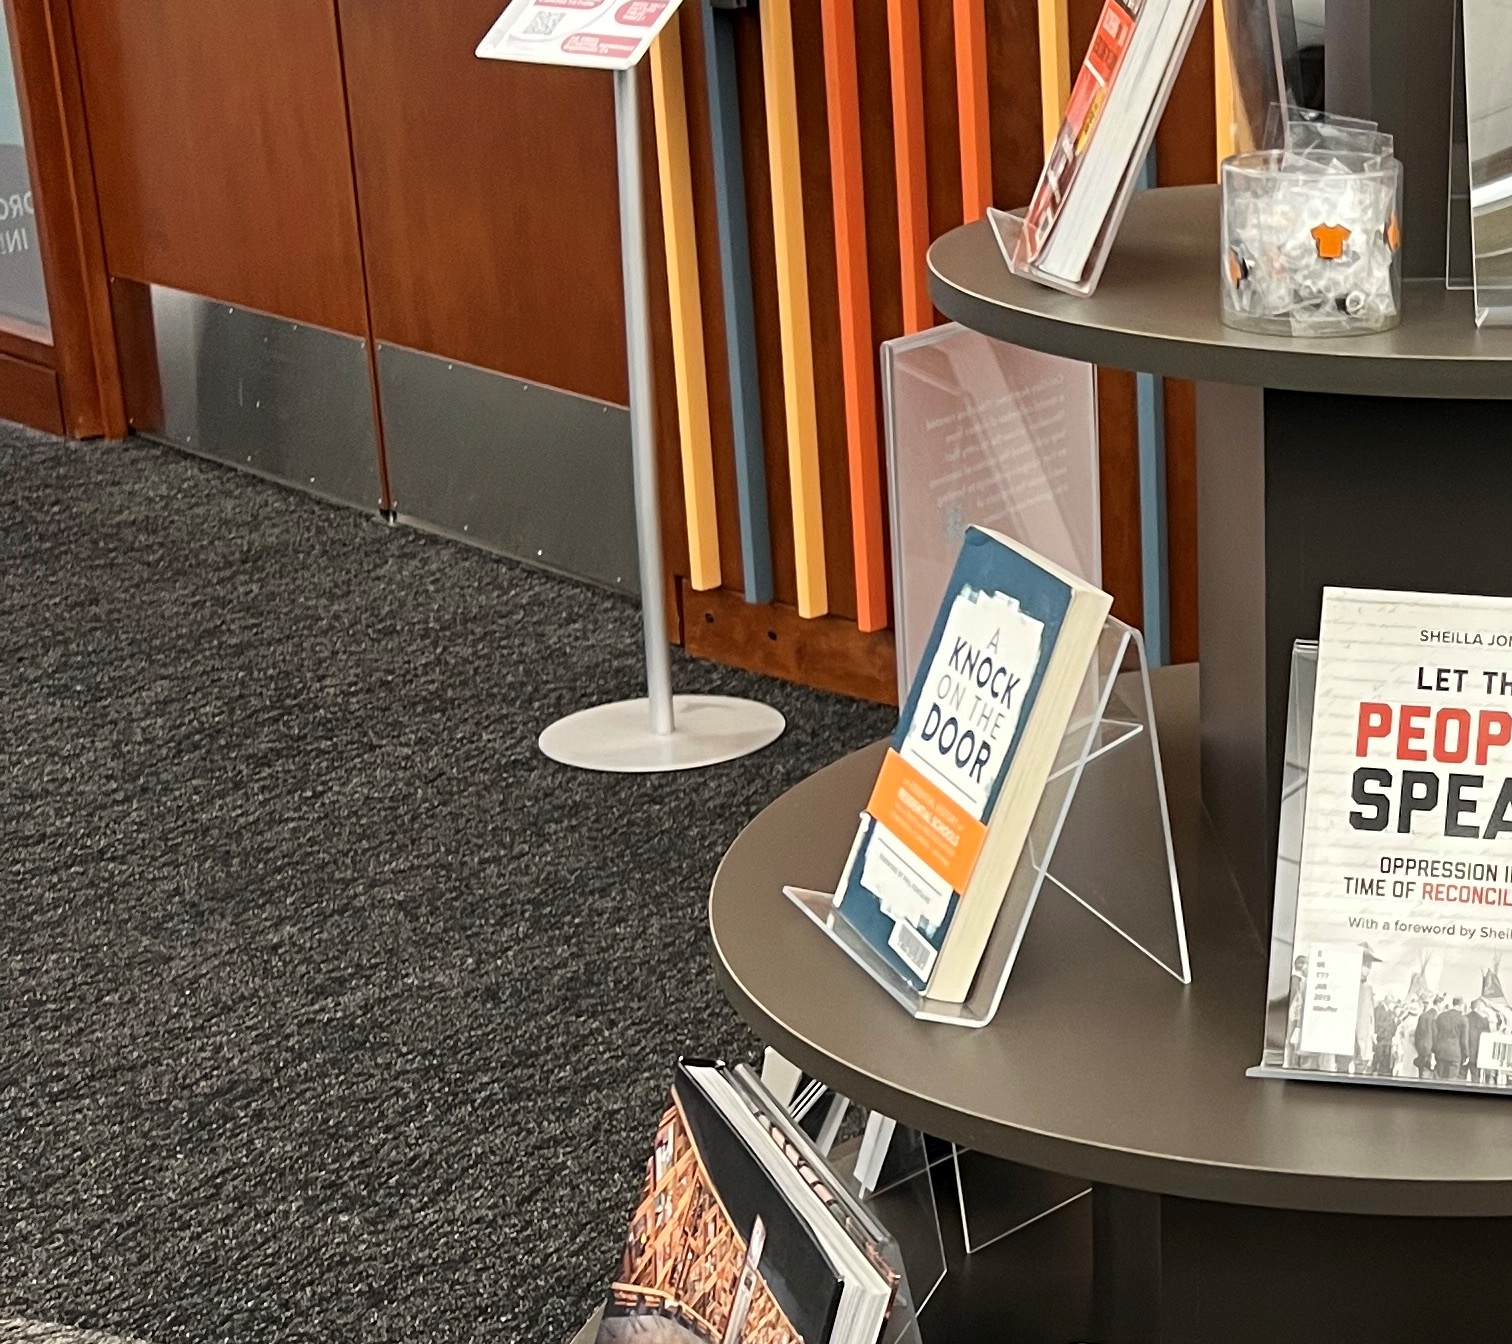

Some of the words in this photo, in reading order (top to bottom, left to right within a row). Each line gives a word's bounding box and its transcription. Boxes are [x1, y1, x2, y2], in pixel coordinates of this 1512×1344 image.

[987, 627, 999, 654] A
[1420, 629, 1483, 646] SHEILLA
[950, 636, 1021, 709] KNOCK
[1417, 666, 1469, 693] LET
[937, 673, 964, 712] ON
[968, 695, 1007, 742] THE
[920, 702, 993, 785] DOOR
[1380, 856, 1498, 883] OPPRESSION
[1344, 876, 1386, 898] TIME
[1392, 879, 1416, 899] OF
[1348, 916, 1379, 931] With
[1382, 921, 1391, 931] a
[1395, 918, 1456, 937] foreword
[1459, 924, 1476, 940] by
